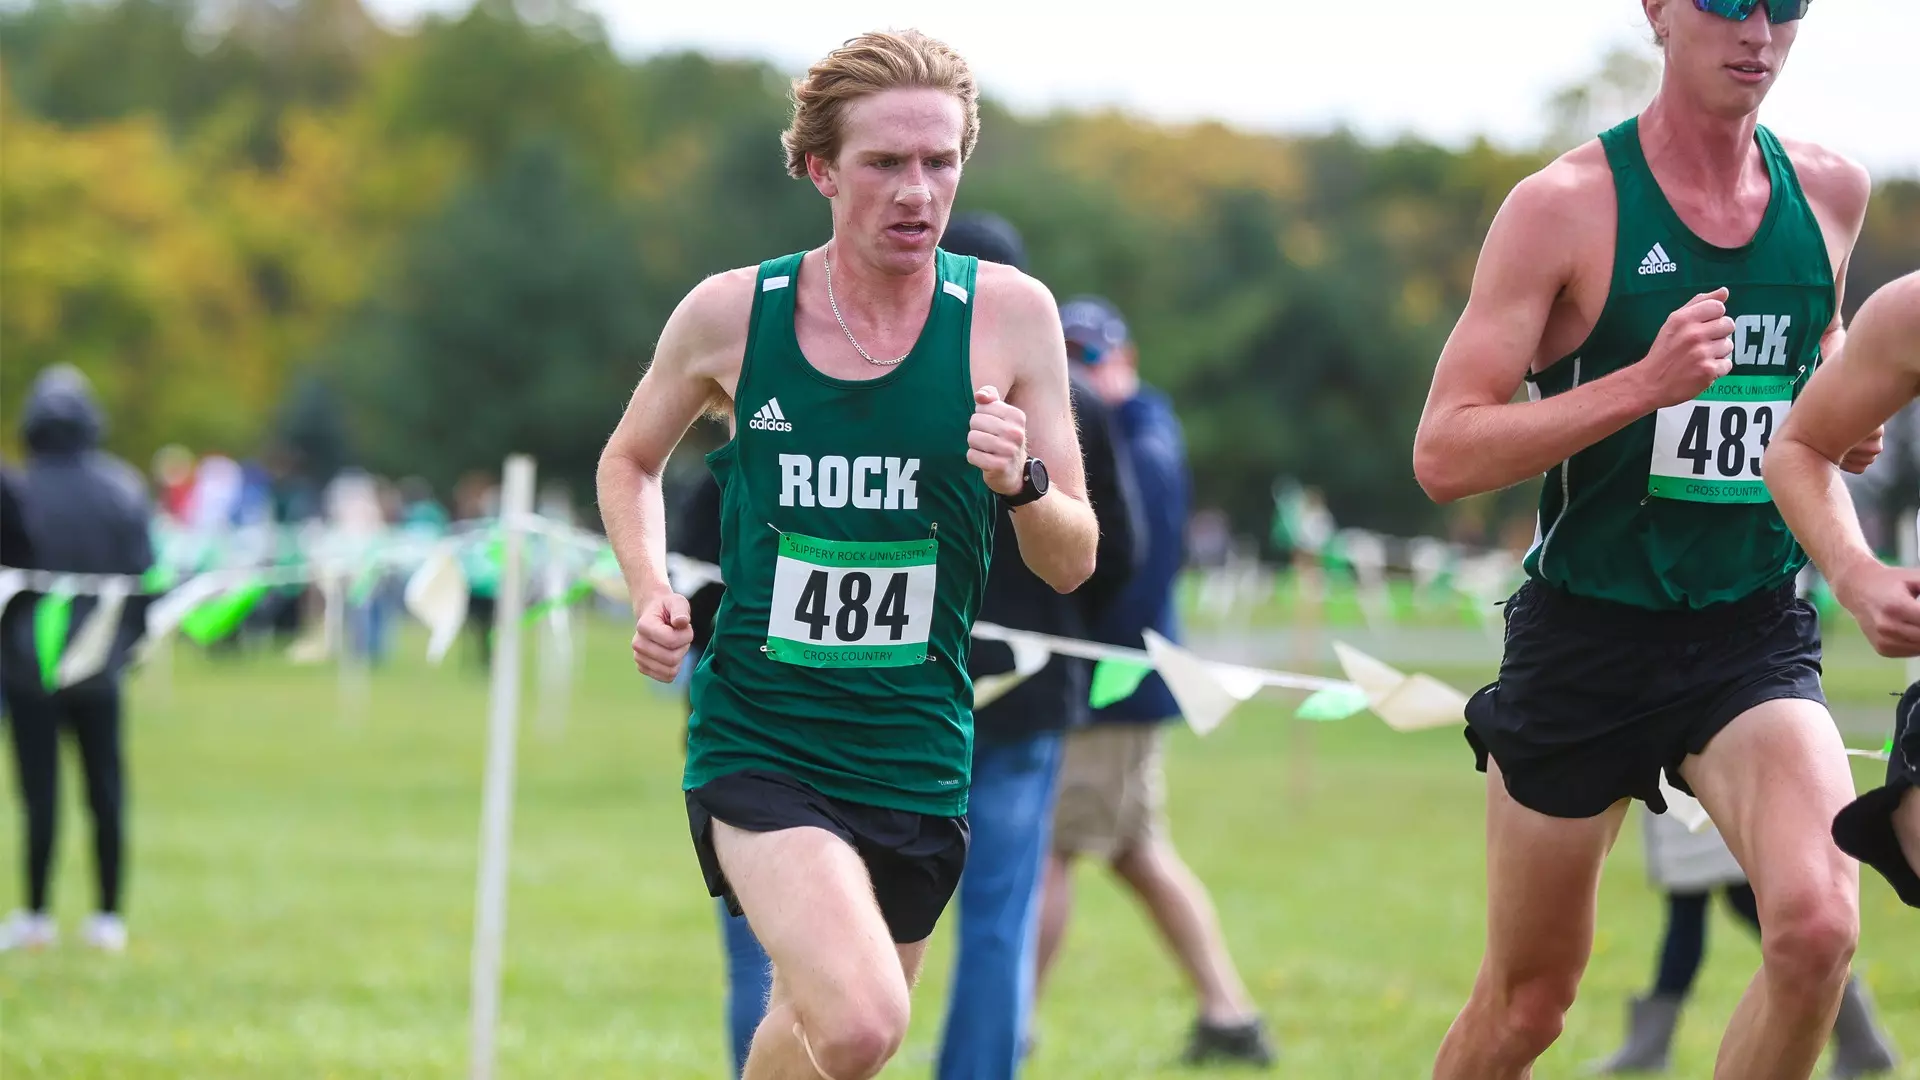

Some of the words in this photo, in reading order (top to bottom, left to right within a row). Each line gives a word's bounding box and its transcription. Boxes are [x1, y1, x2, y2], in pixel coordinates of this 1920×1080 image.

[1638, 261, 1677, 275] adidas
[1725, 314, 1791, 366] CK
[1718, 385, 1743, 395] ROCK
[1745, 384, 1786, 395] UNIVERSITY
[749, 417, 793, 432] adidas
[1677, 406, 1773, 477] 483
[778, 453, 921, 510] ROCK
[1685, 484, 1720, 497] CROSS
[1722, 486, 1763, 497] COUNTRY
[790, 541, 835, 560] SLIPPERY
[837, 551, 866, 561] ROCK
[869, 548, 928, 561] UNIVERSITY
[794, 569, 910, 642] 484
[803, 650, 839, 662] CROSS
[841, 651, 893, 661] COUNTRY
